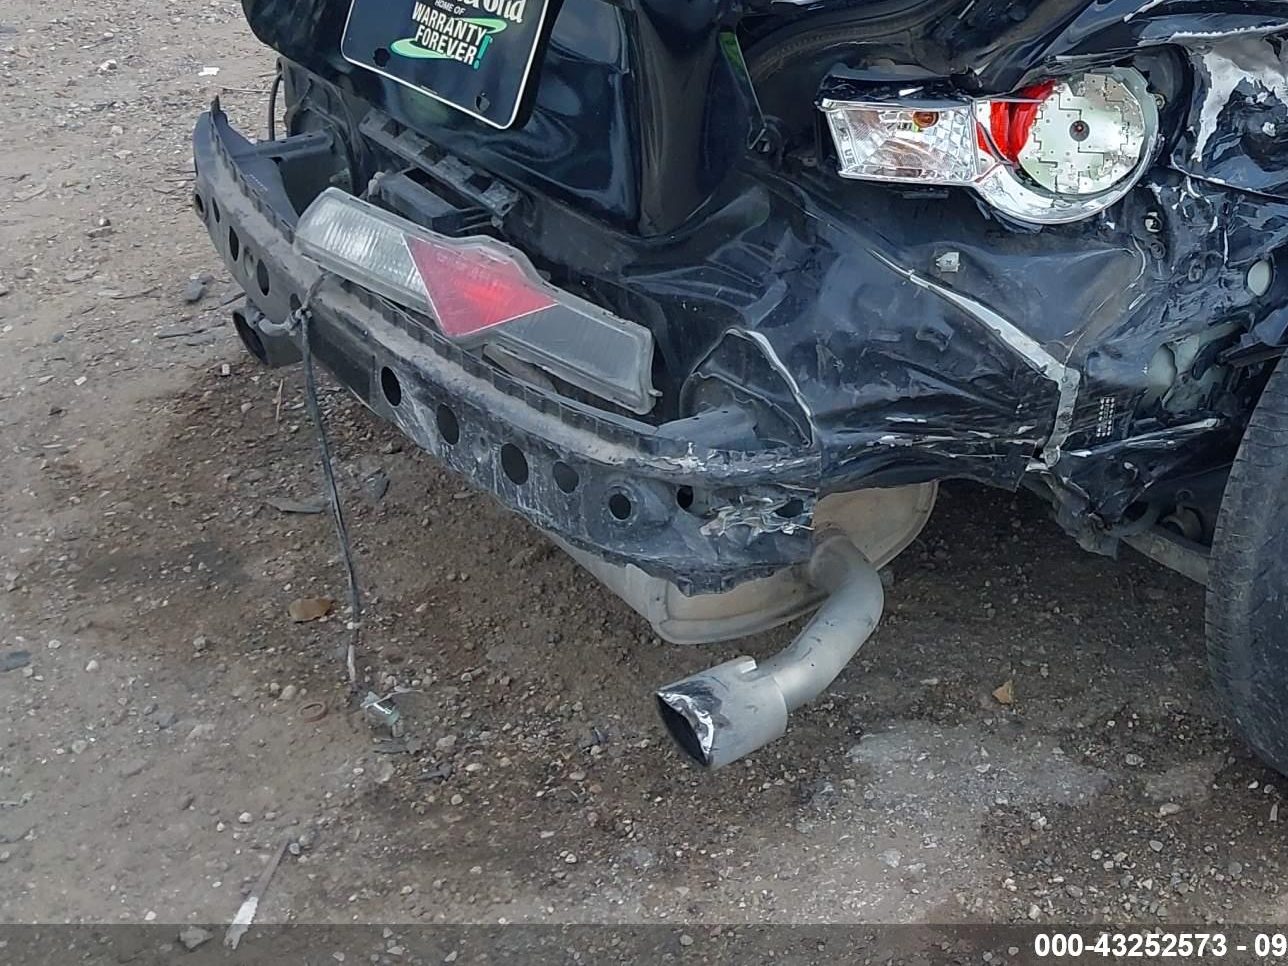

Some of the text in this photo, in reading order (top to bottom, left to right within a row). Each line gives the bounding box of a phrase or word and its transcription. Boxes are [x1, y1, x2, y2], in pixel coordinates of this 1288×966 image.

[412, 2, 487, 46] WARRANTY
[453, 5, 466, 16] OF
[415, 25, 493, 69] FOREVER!
